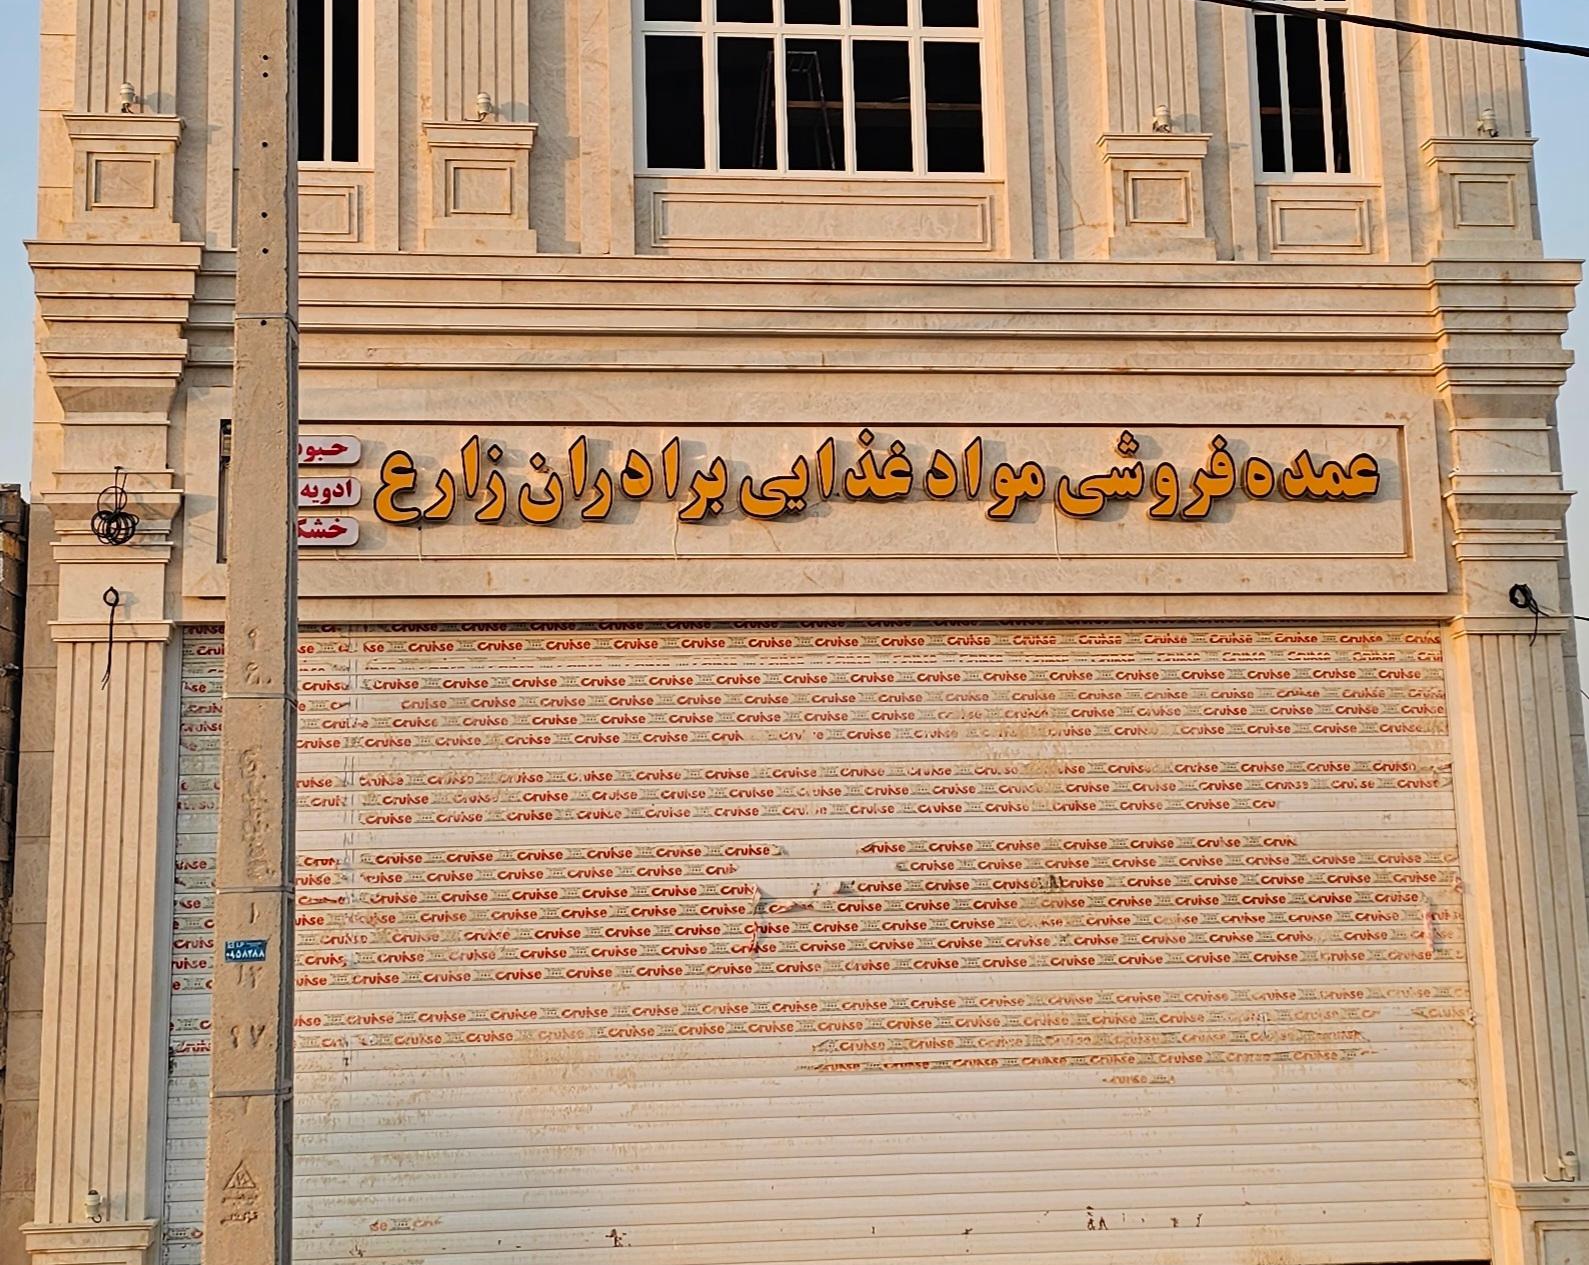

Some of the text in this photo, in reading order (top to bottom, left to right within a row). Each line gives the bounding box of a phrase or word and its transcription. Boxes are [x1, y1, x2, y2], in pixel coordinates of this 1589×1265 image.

[373, 427, 1380, 525] عمده فروشی مواد غذایی برادران زارع
[300, 478, 352, 505] ادویه
[408, 641, 454, 653] Cruise
[477, 640, 524, 651] Cruise
[546, 639, 591, 651] Cruise
[614, 638, 658, 649] Cruise
[681, 638, 726, 649] Cruise
[748, 638, 792, 648] Cruise
[814, 636, 859, 647] Cruise
[443, 679, 489, 688] Cruise
[512, 678, 557, 688] Cruise
[579, 677, 625, 687] Cruise
[649, 675, 693, 686] Cruise
[812, 694, 860, 706] Cruise
[600, 715, 646, 725] Cruise
[668, 714, 714, 725] Cruise
[1071, 707, 1115, 718] Cruise
[574, 733, 620, 745] Cruise
[375, 853, 423, 864] Cruise
[447, 851, 495, 862] Cruise
[517, 849, 563, 861] Cruise
[587, 848, 633, 859] Cruise
[656, 848, 702, 858] Cruise
[996, 840, 1041, 851] Cruise
[1113, 858, 1157, 868] Cruise
[1312, 855, 1357, 864] Cruise
[857, 881, 902, 892] Cruise
[925, 881, 970, 891] Cruise
[1194, 875, 1239, 886] Cruise
[441, 891, 488, 902] Cruise
[512, 890, 560, 901] Cruise
[582, 888, 629, 900] Cruise
[651, 886, 697, 896] Cruise
[561, 908, 608, 919] Cruise
[630, 906, 677, 918] Cruise
[906, 900, 949, 912] Cruise
[1108, 896, 1152, 907] Cruise
[1242, 894, 1286, 905] Cruise
[535, 928, 581, 939] Cruise
[812, 922, 859, 933] Cruise
[800, 943, 846, 952] Cruise
[937, 938, 983, 949] Cruise
[1209, 932, 1254, 944] Cruise
[636, 966, 684, 976] Cruise
